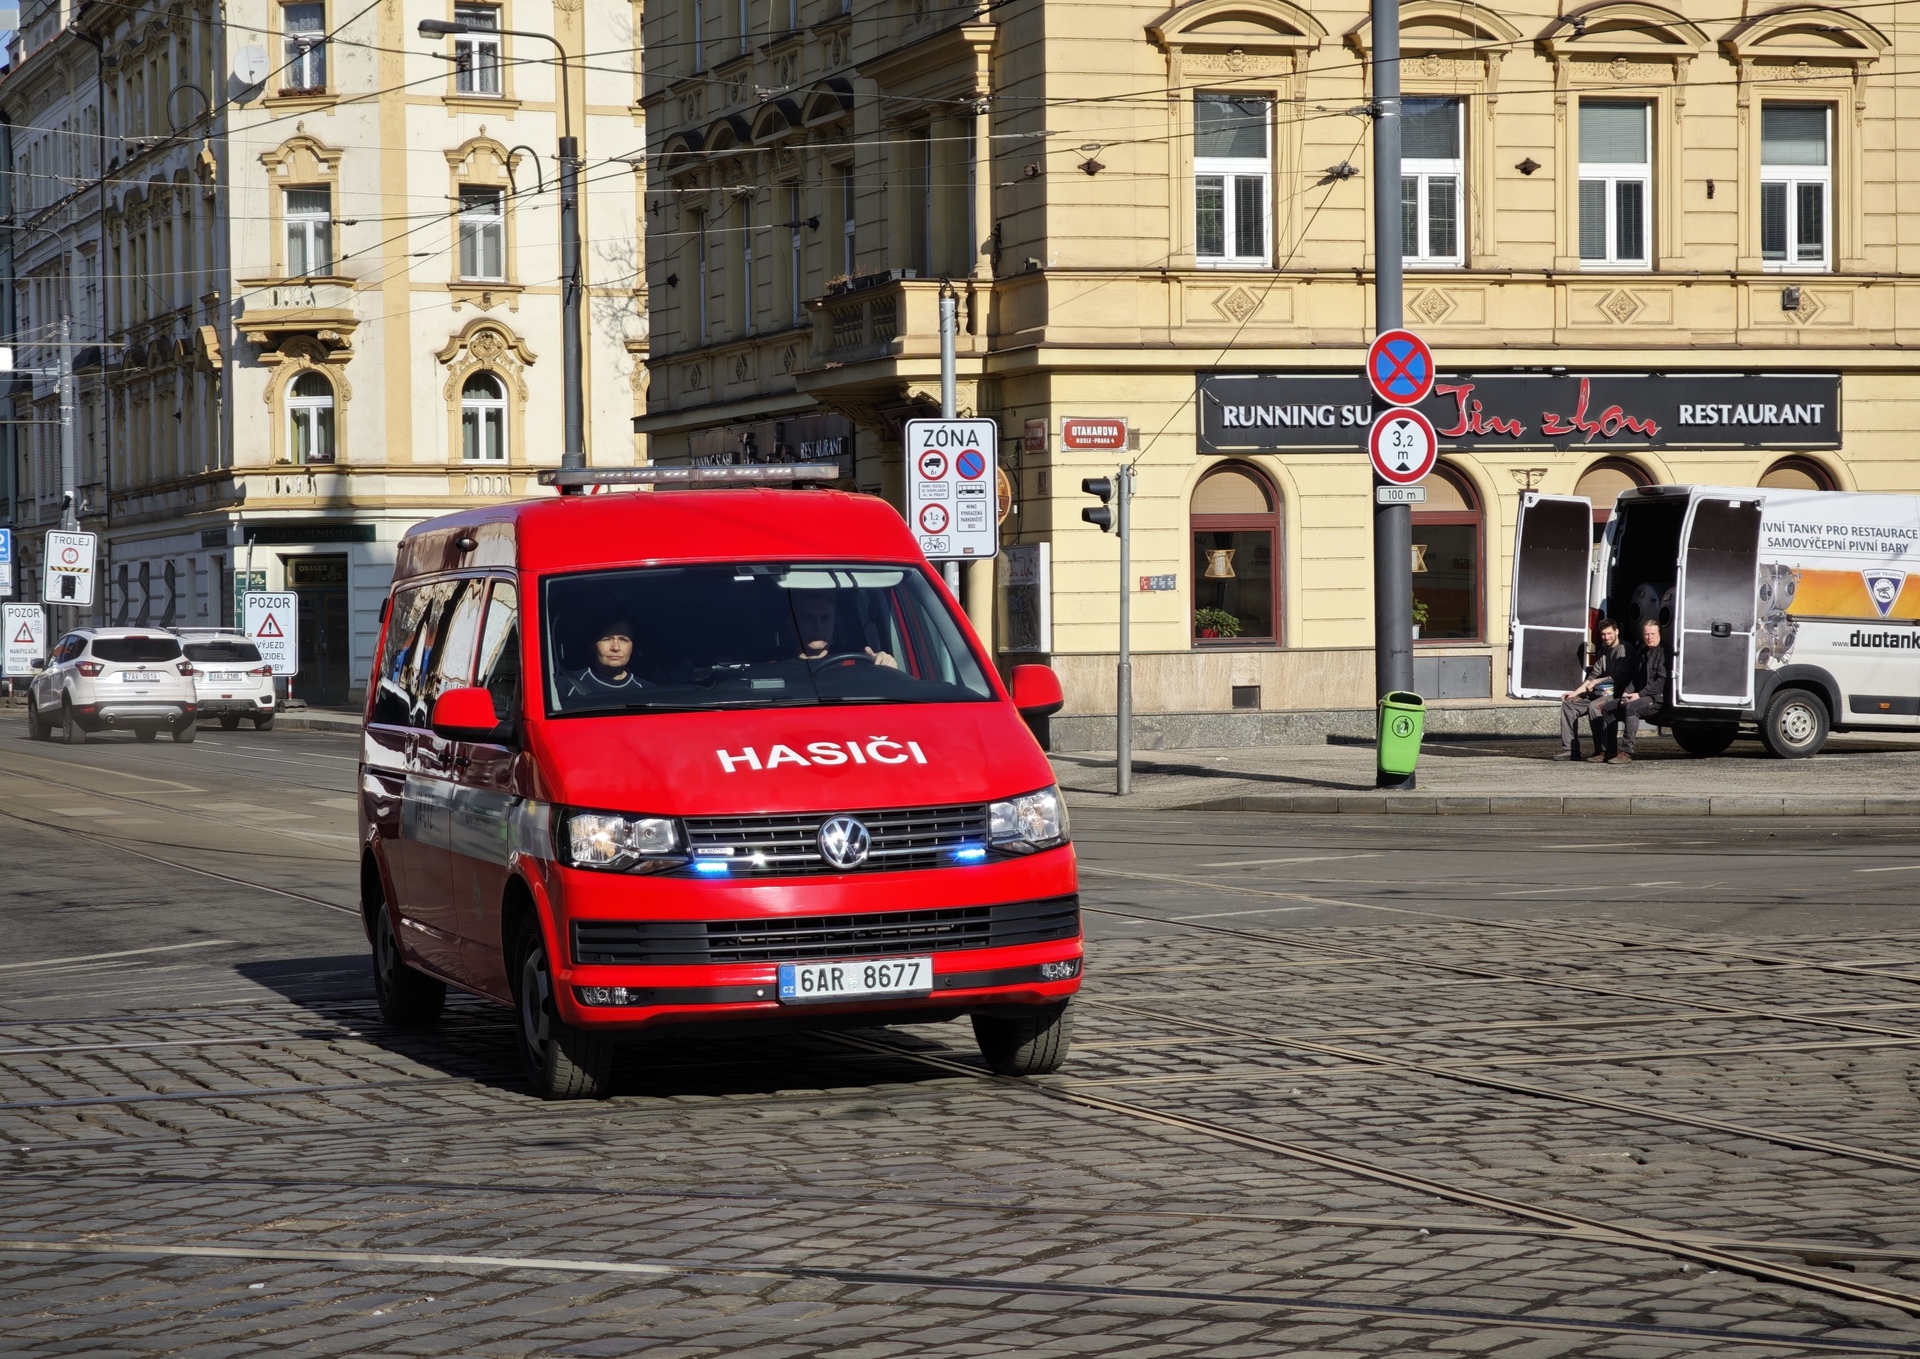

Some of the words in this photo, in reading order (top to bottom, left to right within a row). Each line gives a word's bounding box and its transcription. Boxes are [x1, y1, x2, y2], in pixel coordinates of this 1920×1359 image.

[1223, 405, 1336, 426] RUNNING
[1341, 405, 1373, 426] SU
[1679, 404, 1825, 424] RESTAURANT
[923, 425, 980, 447] ZÓNA
[1071, 426, 1118, 436] OTAKAROVA
[1392, 430, 1414, 448] 3,2
[801, 437, 843, 459] RESTAURANT
[1397, 450, 1409, 460] m
[1388, 490, 1403, 500] 100
[1406, 491, 1416, 500] m
[1762, 521, 1786, 533] IVNÍ
[1788, 523, 1823, 535] TANKY
[1826, 525, 1849, 536] PRO
[1851, 526, 1919, 540] RESTAURACE
[53, 535, 90, 546] TROLEJ
[1767, 537, 1846, 550] SAMOVÝČEPNÍ
[1849, 540, 1878, 552] PIVNÍ
[1881, 542, 1909, 553] BARY
[298, 564, 328, 572] ONAGER
[249, 597, 290, 609] POZOR
[8, 608, 40, 618] POZOR
[256, 640, 285, 649] VÝJEZD
[716, 736, 928, 773] HASIČI
[801, 967, 845, 992] 6AR
[864, 962, 920, 989] 8677
[783, 985, 794, 993] CZ
